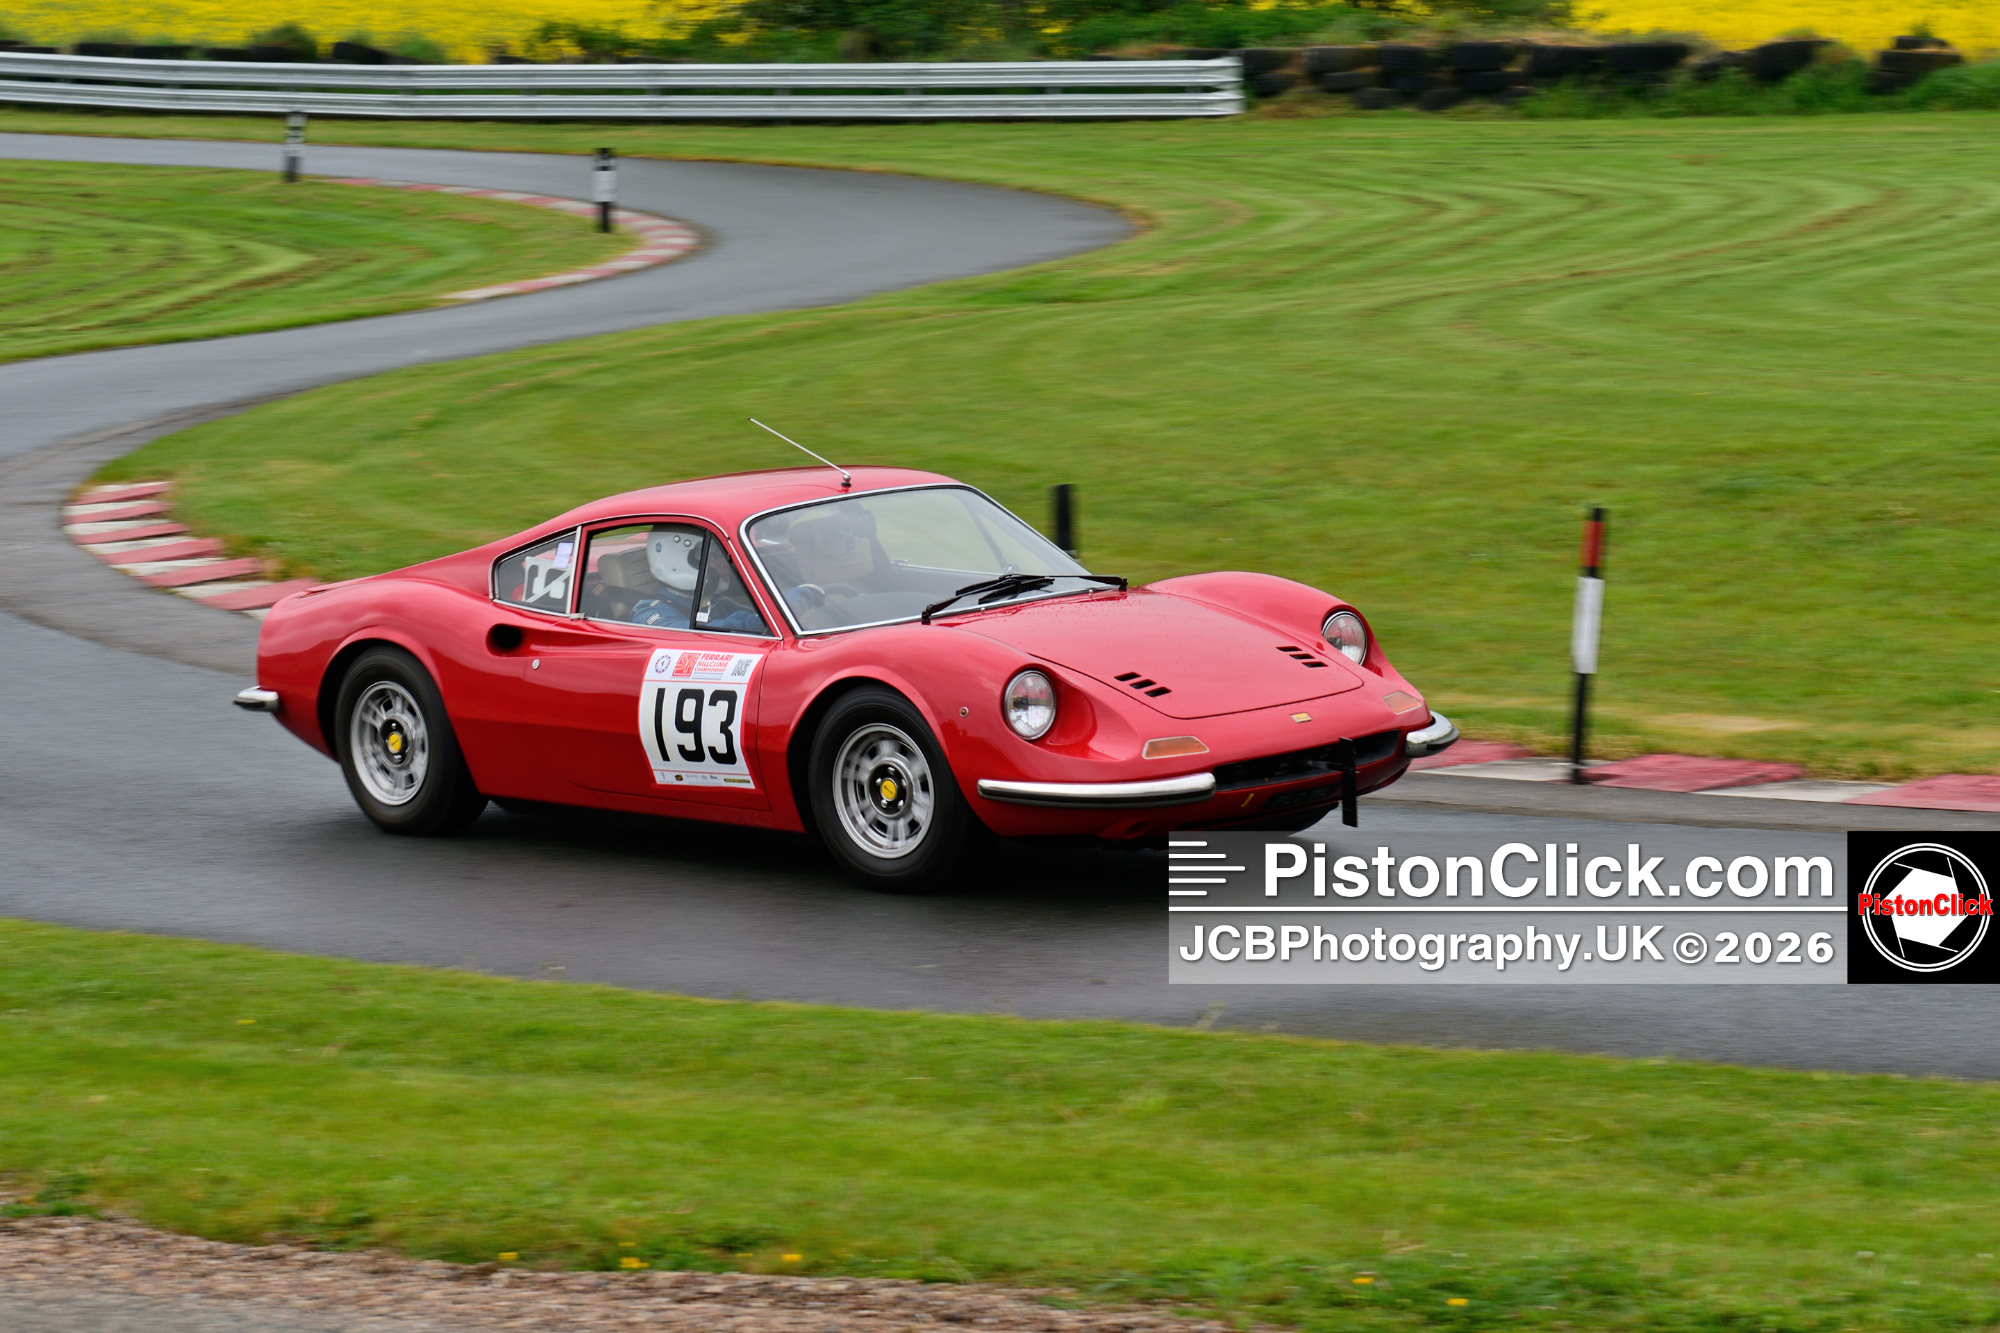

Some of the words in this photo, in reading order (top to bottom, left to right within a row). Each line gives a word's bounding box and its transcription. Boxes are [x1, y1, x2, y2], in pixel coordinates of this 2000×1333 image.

[701, 653, 734, 662] FERRARI
[697, 660, 729, 668] HILLCLIMB
[654, 687, 738, 765] 193
